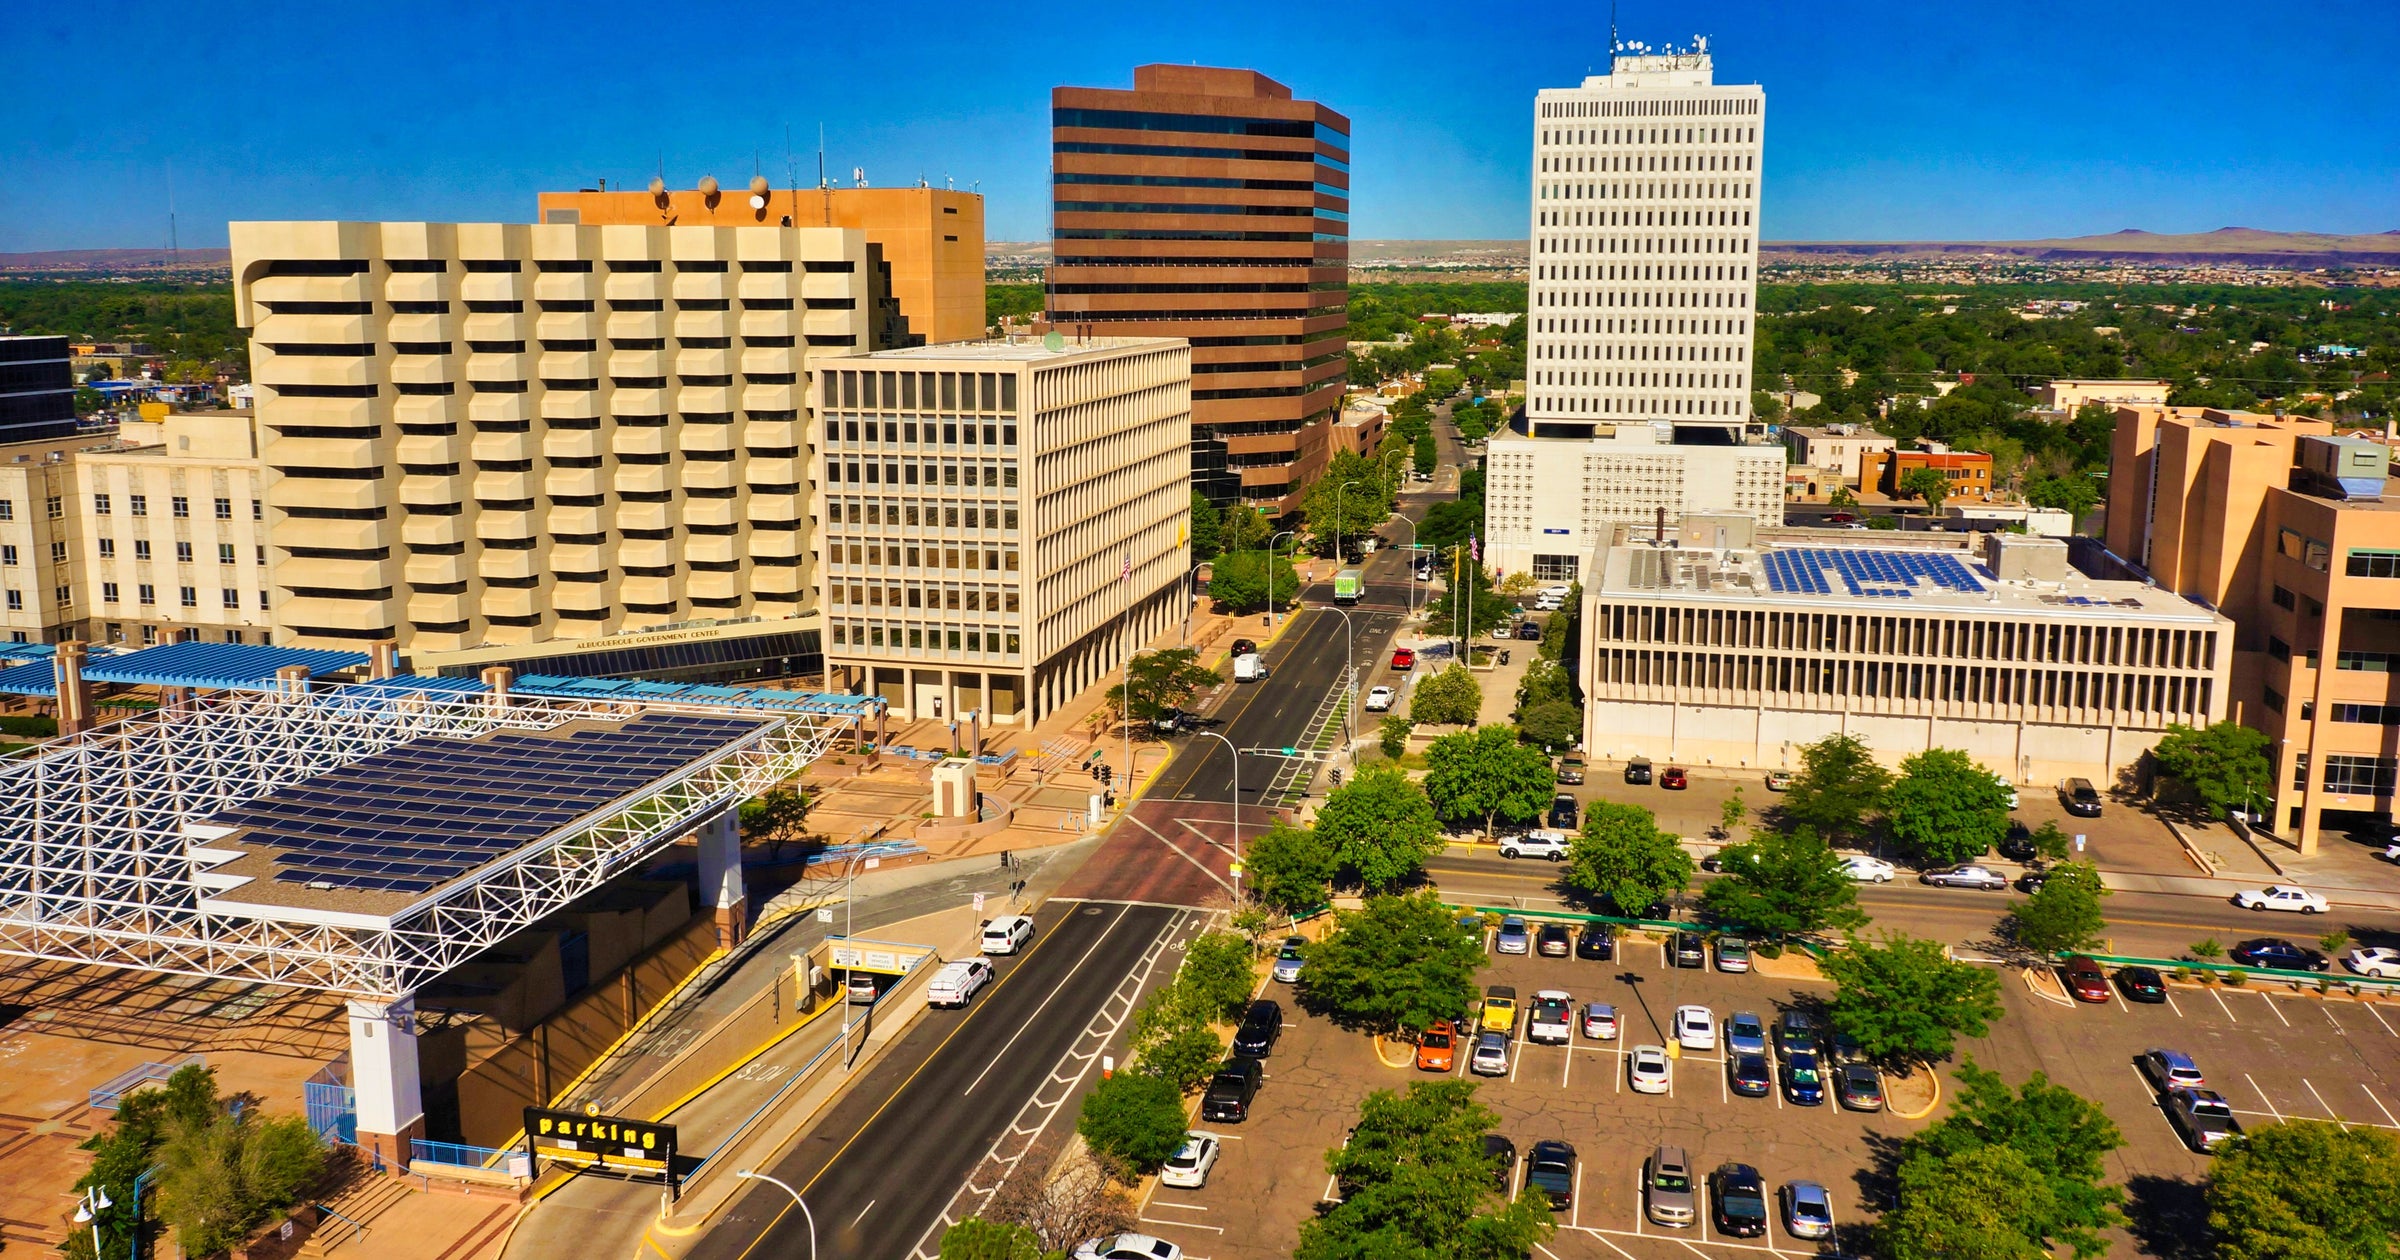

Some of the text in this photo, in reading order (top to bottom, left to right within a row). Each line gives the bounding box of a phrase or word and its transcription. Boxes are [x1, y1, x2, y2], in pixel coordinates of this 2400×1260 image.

[576, 629, 720, 649] ALBUQUERQUE GOVERNMENT CENTER
[539, 1118, 656, 1149] parking
